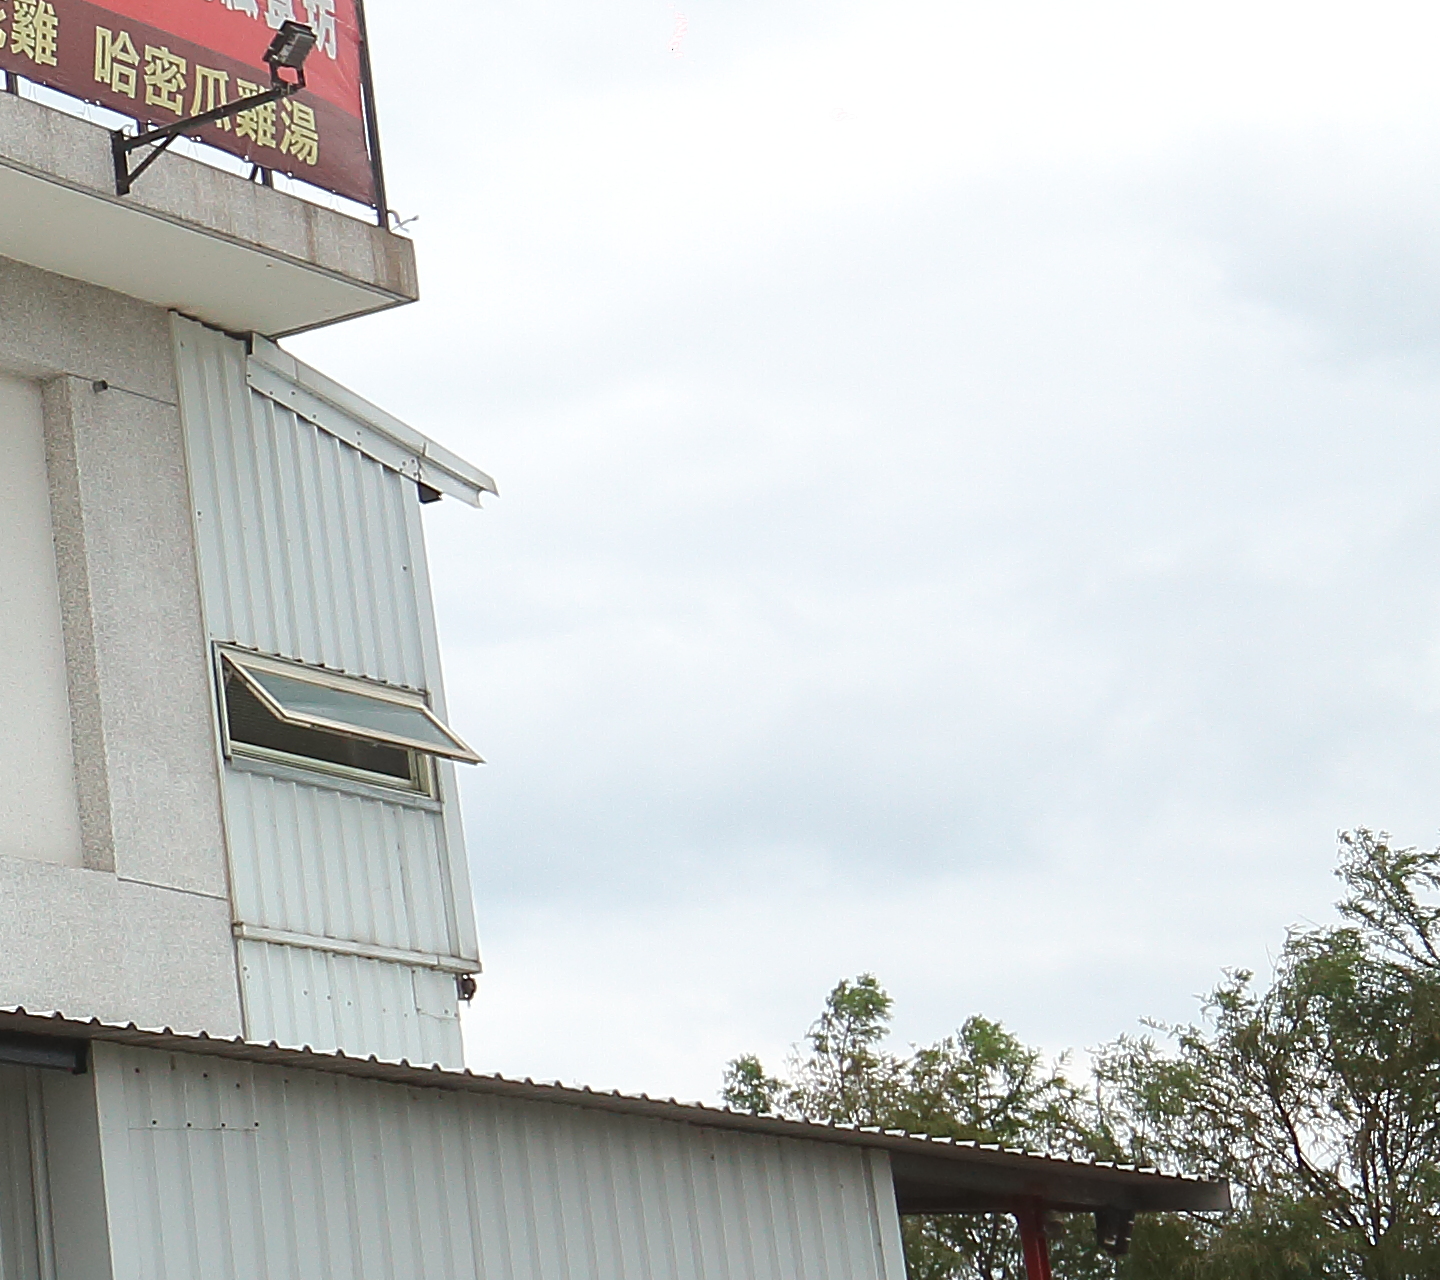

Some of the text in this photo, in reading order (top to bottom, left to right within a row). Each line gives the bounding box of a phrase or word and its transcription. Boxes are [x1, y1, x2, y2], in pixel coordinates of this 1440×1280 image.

[93, 25, 320, 167] 哈密瓜雞湯
